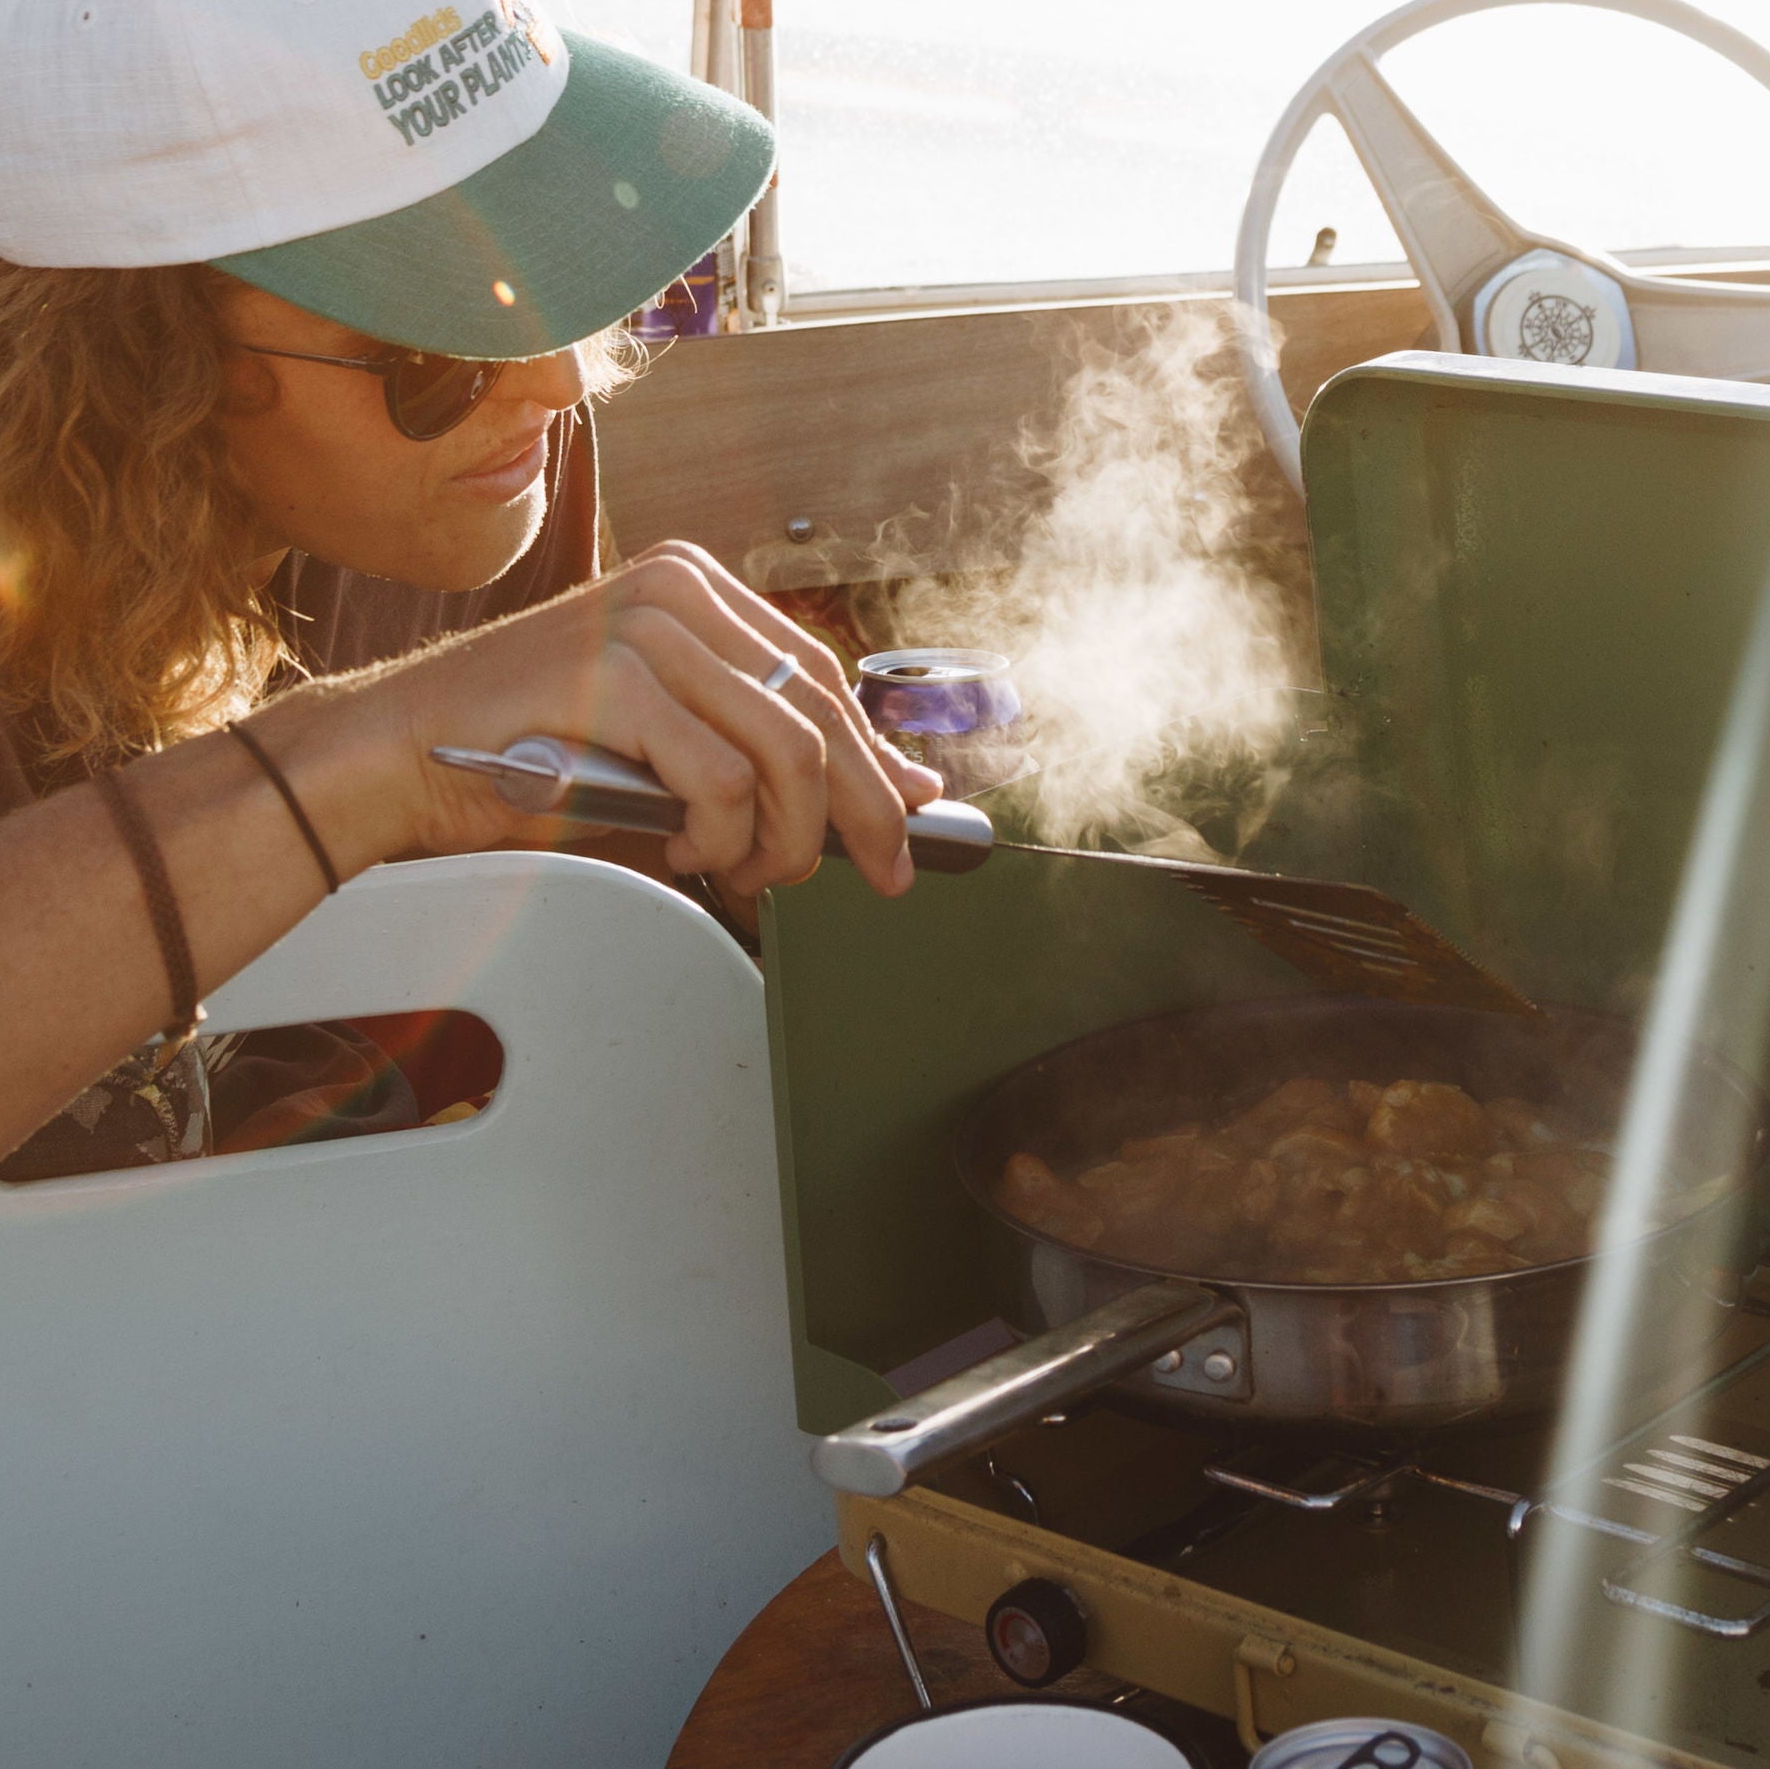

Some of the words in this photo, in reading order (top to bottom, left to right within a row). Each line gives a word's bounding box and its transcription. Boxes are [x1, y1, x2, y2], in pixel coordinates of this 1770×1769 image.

[373, 54, 440, 110] LOOK
[438, 10, 501, 73] AFTER
[387, 80, 467, 146] YOUR
